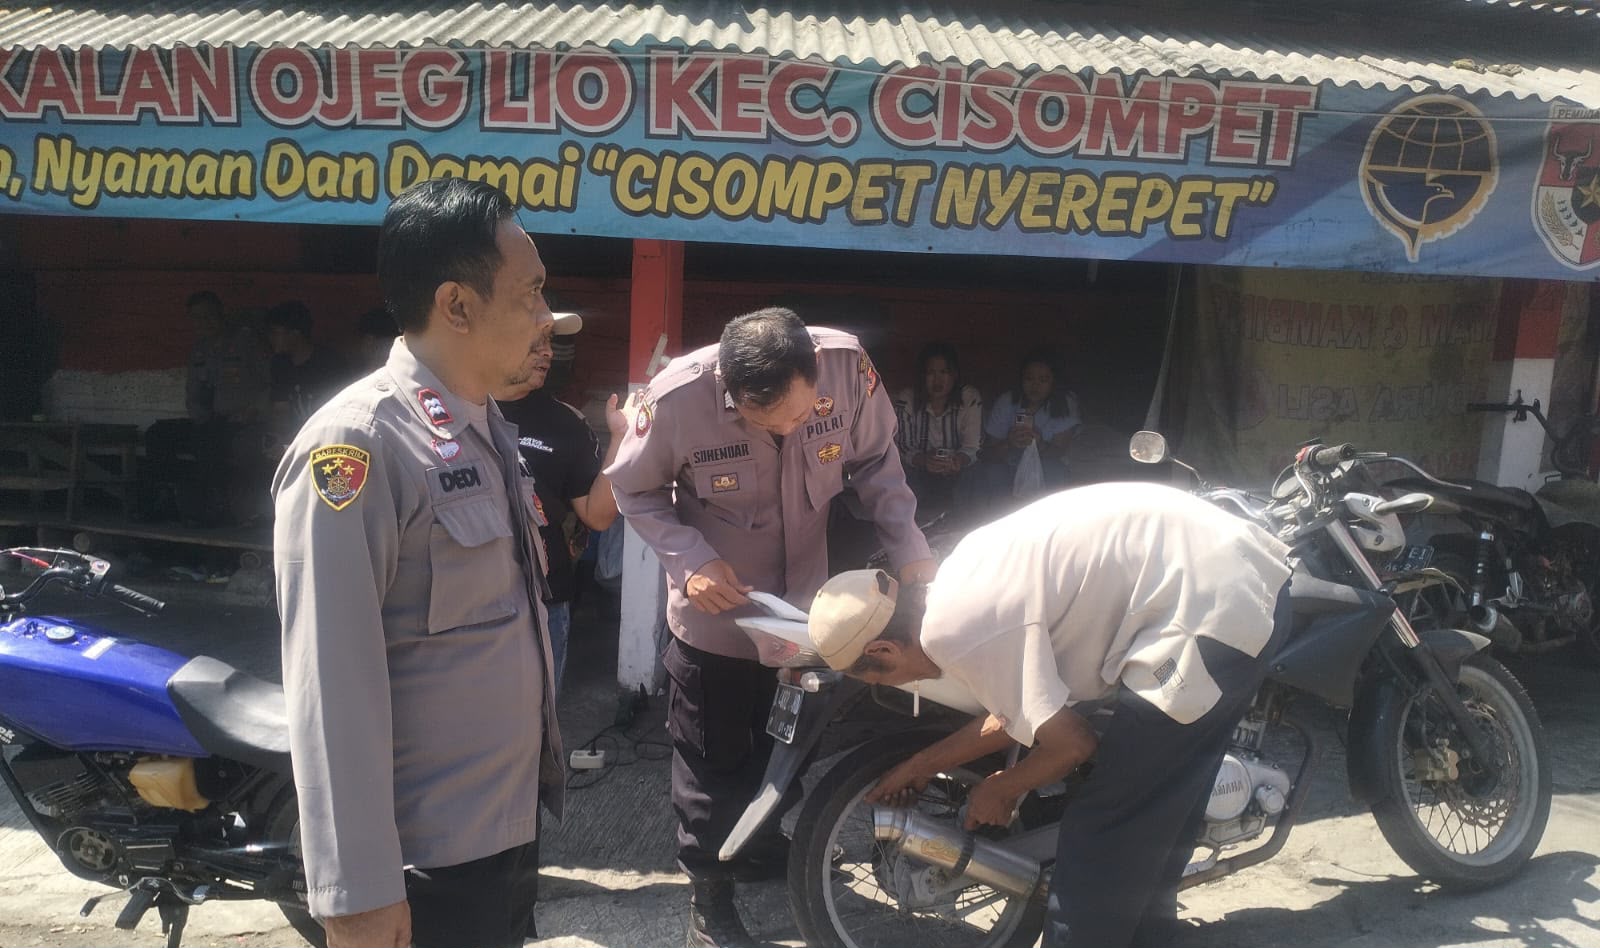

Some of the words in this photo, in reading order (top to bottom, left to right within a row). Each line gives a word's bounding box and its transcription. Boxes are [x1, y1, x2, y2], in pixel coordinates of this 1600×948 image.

[252, 44, 468, 128] OJEG
[481, 46, 632, 134] LIO
[648, 49, 857, 144] KEC.
[873, 62, 1318, 167] CISOMPET
[34, 138, 253, 206] Nyaman
[266, 142, 374, 200] Dan
[591, 148, 931, 222] “CISOMPET
[935, 167, 1276, 238] NYEREPET”
[806, 414, 844, 439] POLRI
[438, 465, 482, 493] DEDI
[1211, 780, 1244, 797] AMAHA
